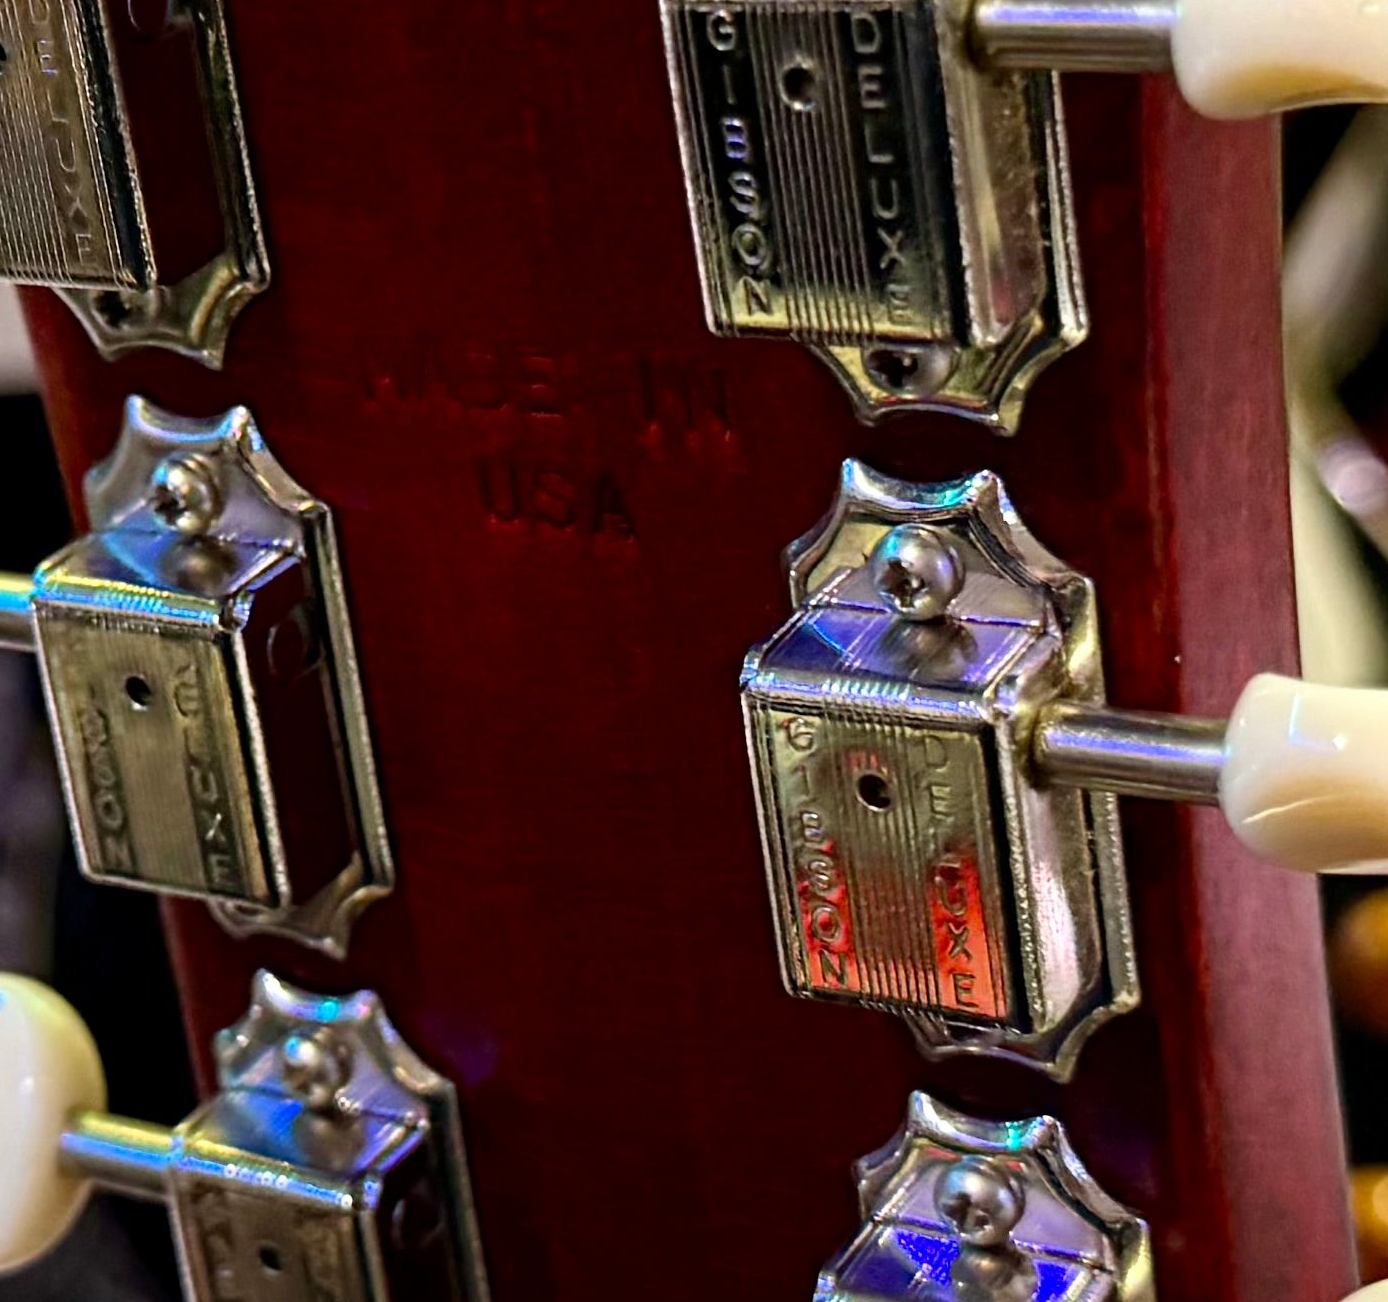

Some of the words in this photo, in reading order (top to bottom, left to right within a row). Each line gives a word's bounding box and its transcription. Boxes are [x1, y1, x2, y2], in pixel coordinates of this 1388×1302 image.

[706, 10, 773, 316] GIBSON
[850, 11, 914, 325] DELUXE
[475, 455, 639, 535] USA
[783, 716, 850, 989] GIBSON
